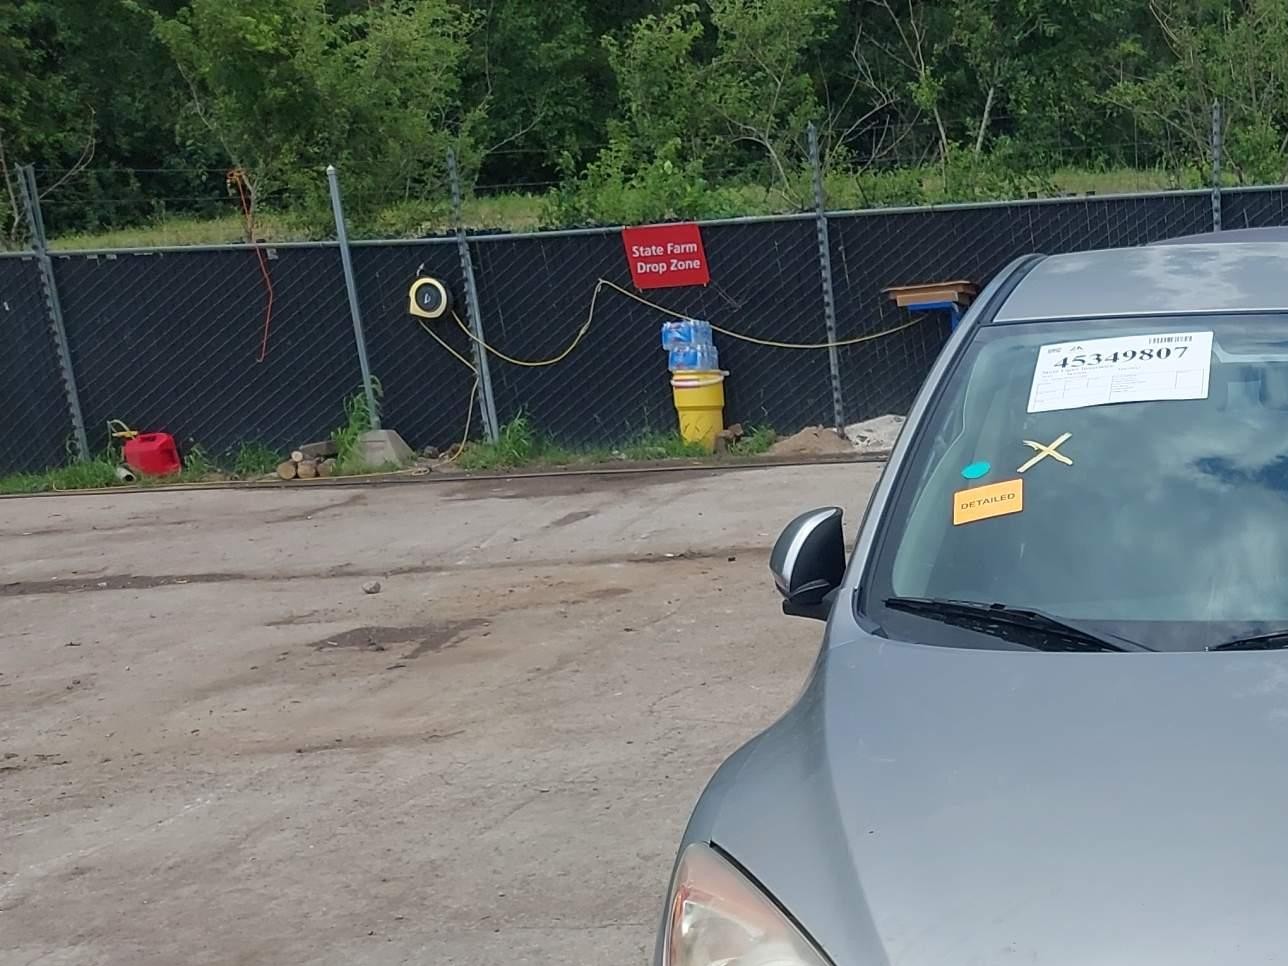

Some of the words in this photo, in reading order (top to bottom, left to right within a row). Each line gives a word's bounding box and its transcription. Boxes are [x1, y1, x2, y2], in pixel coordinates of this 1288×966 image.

[632, 245, 664, 258] State
[667, 243, 697, 254] Farm
[637, 262, 667, 274] Drop
[670, 259, 700, 270] Zone
[1054, 346, 1188, 369] 45349807
[961, 492, 1015, 510] DETAILED
